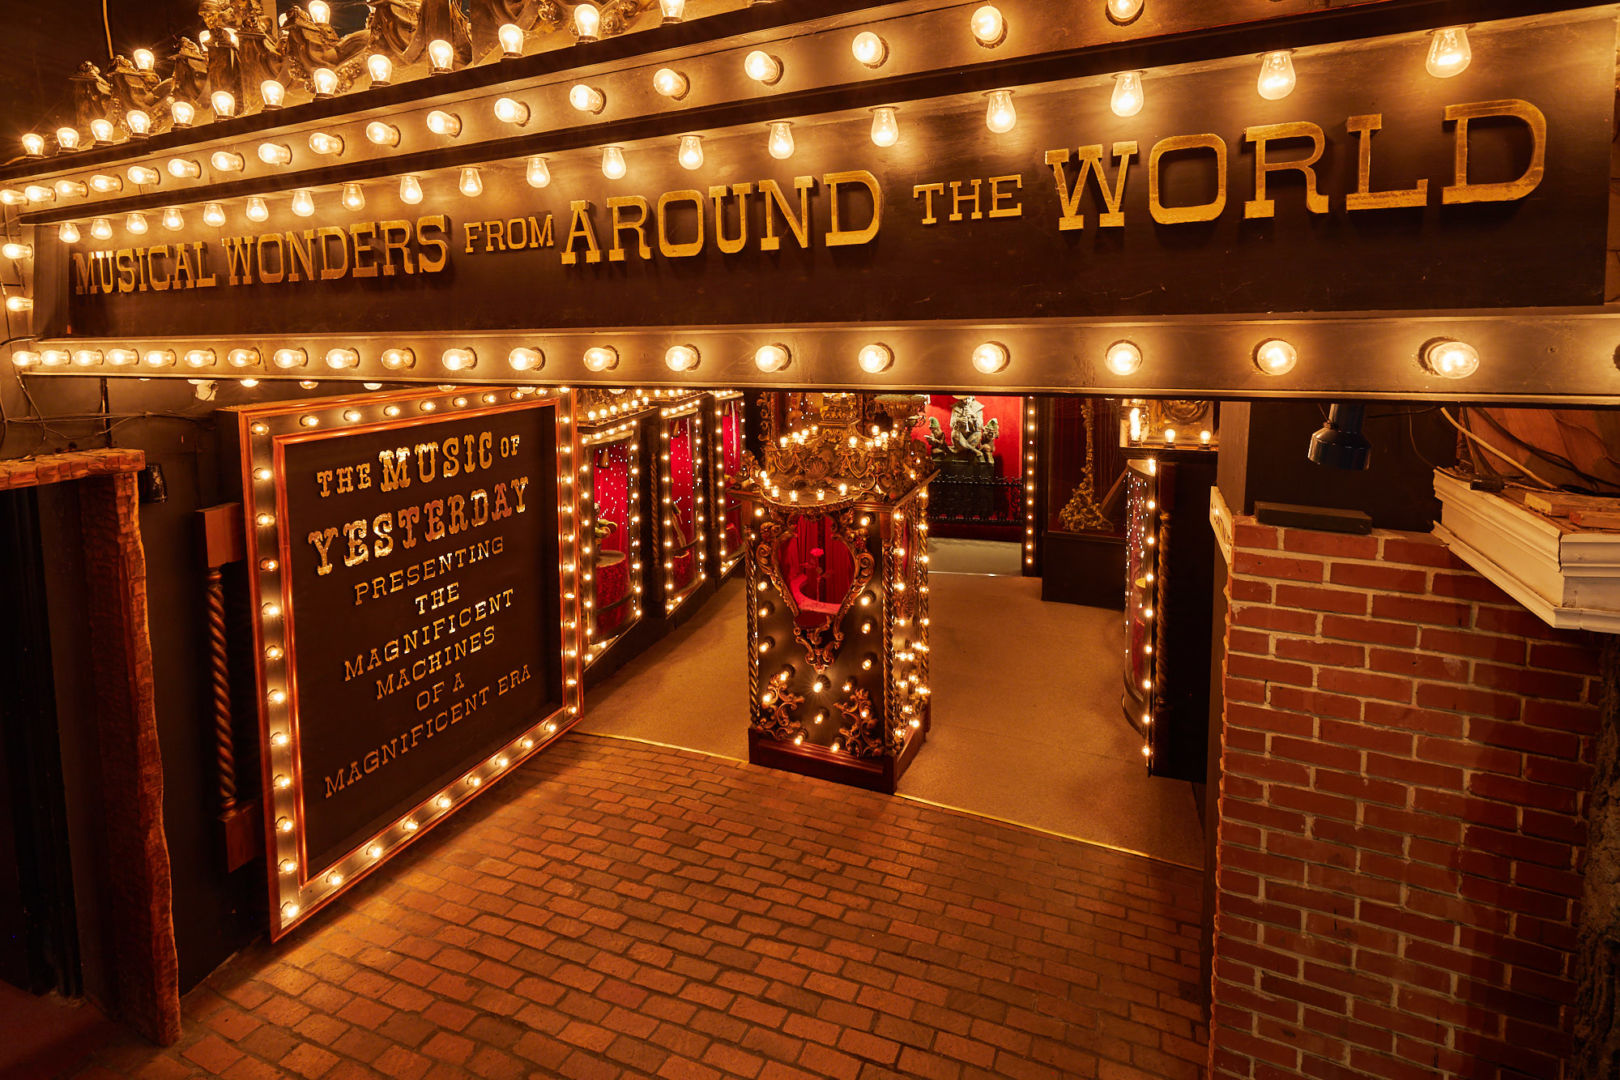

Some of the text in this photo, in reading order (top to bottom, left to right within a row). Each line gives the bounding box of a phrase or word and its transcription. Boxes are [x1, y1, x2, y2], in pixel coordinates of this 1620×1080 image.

[72, 99, 1547, 296] MUSICAL WONDERS FROM AROUND THE WORLD
[316, 431, 520, 498] THE MUSIC OF
[307, 476, 529, 576] YESTERDAY
[354, 536, 504, 606] PRESENTING
[415, 582, 460, 615] THE
[344, 588, 514, 682] MAGNIFICENT
[375, 625, 495, 700] MACHINES
[416, 672, 465, 711] OF A
[324, 664, 532, 799] MAGNIFICENT ERA
